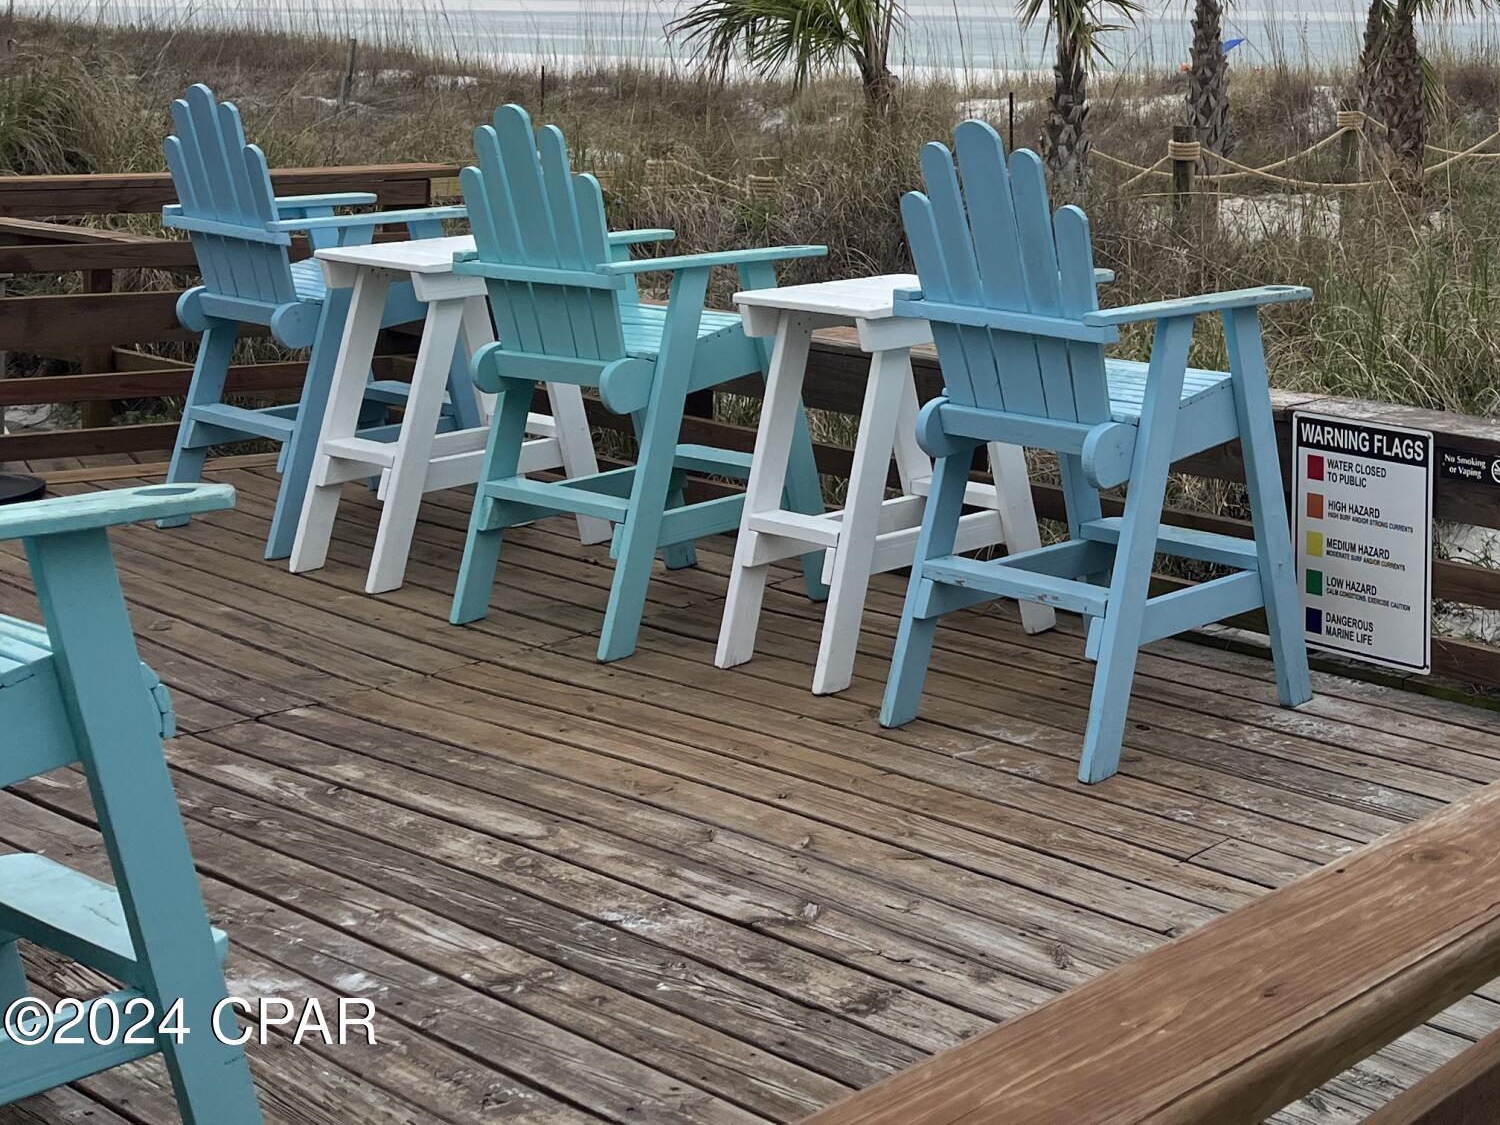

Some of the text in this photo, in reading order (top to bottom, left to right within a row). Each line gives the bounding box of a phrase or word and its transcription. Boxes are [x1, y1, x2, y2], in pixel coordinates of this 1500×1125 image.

[1301, 422, 1424, 461] WARNING FLAGS
[1327, 459, 1387, 478] WATER CLOSED
[1445, 454, 1486, 469] No Smoking
[1327, 472, 1367, 487] TO PUBLIC
[1458, 466, 1482, 479] Vaping
[1328, 500, 1380, 518] HIGH HAZARD
[1370, 519, 1388, 528] STRONG
[1389, 523, 1413, 533] CURRENTS
[1326, 538, 1390, 559] MEDIUM HAZARD
[1381, 561, 1405, 571] CURRENTS
[1326, 576, 1377, 596] LOW HAZARD
[1368, 597, 1390, 608] EXERCISE
[1391, 601, 1411, 612] CAUTION
[1326, 612, 1373, 632] DANGEROUS
[1326, 626, 1373, 646] MARINE LIFE
